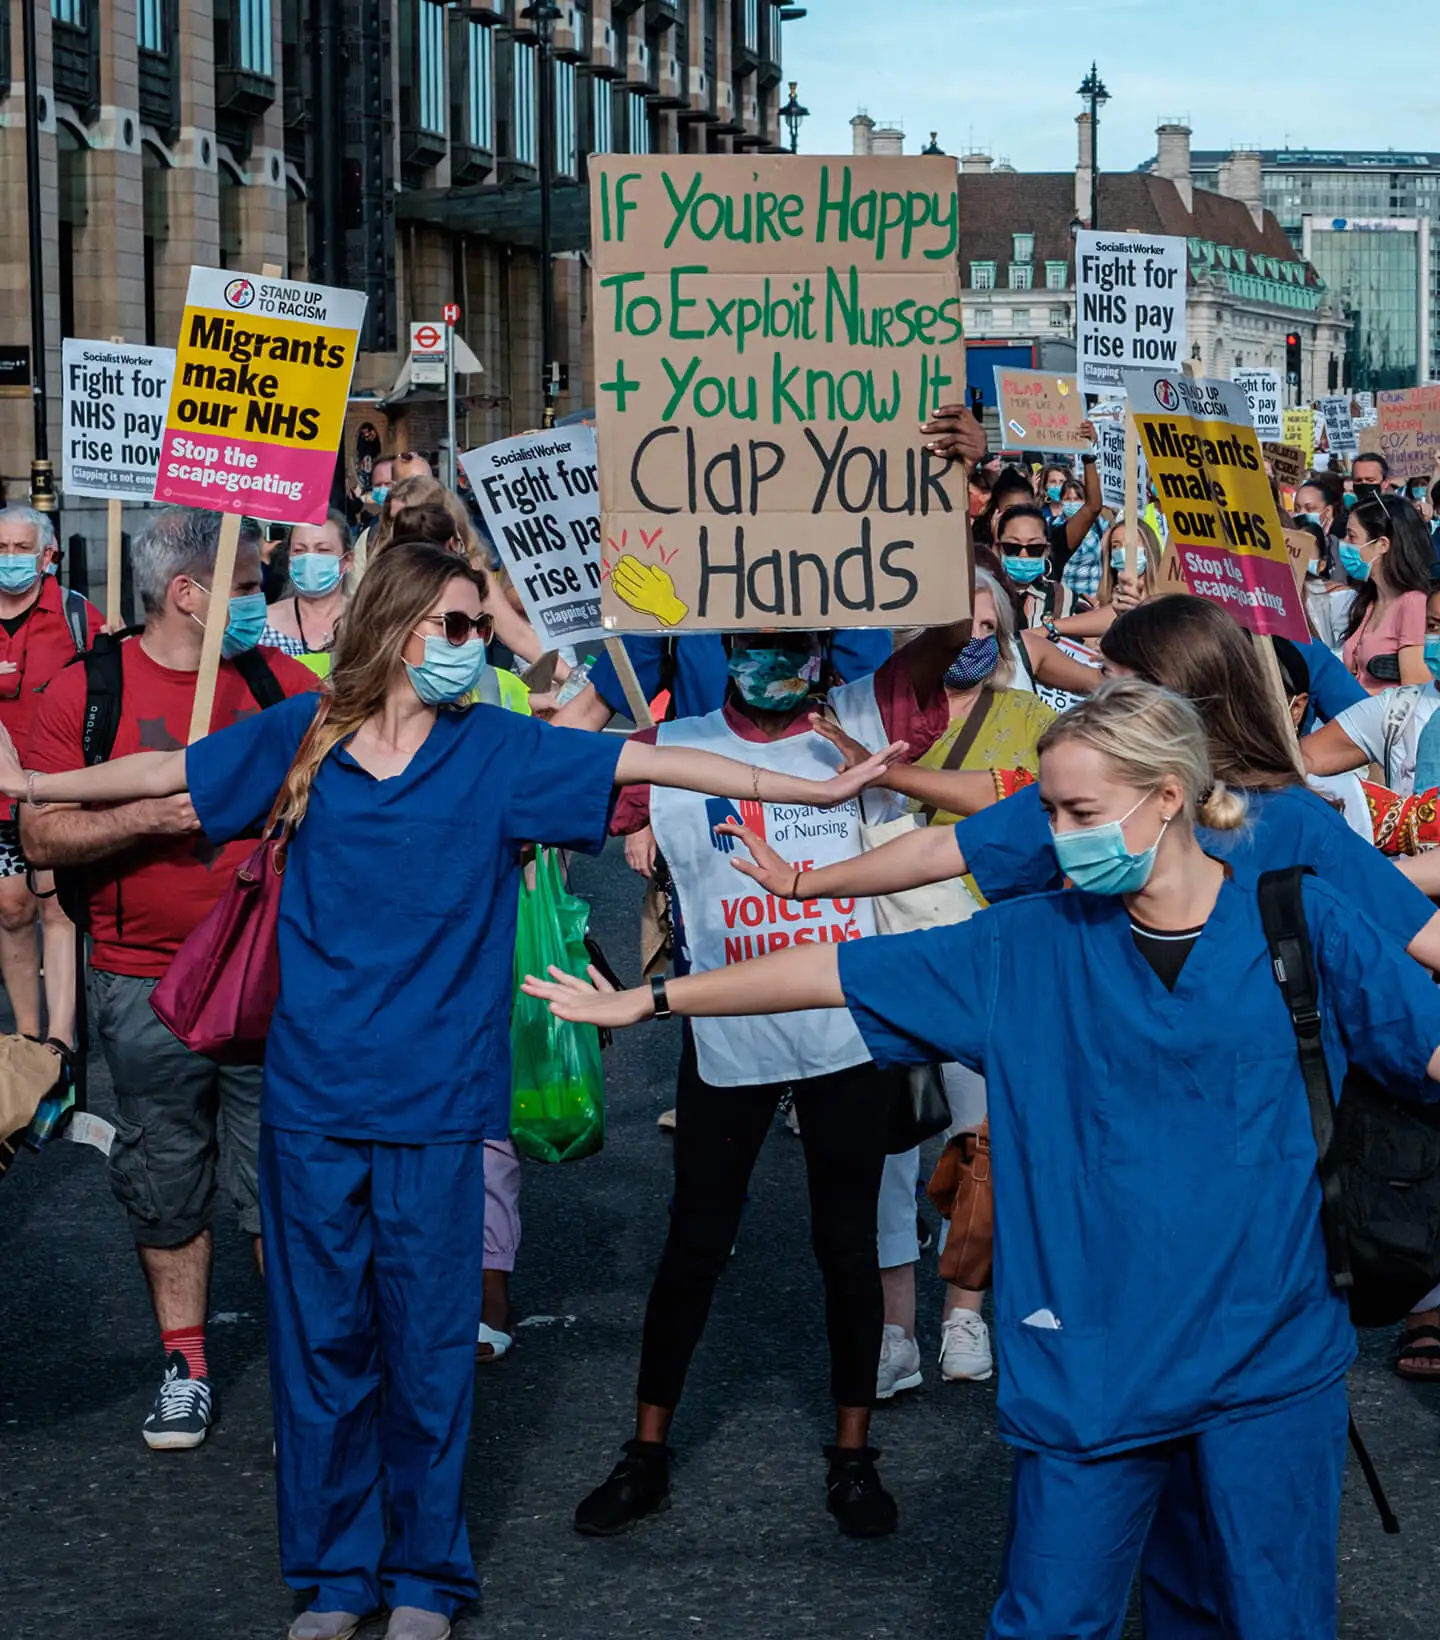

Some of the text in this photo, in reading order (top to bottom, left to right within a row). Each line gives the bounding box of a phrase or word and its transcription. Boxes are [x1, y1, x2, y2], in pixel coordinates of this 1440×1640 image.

[815, 165, 958, 260] Happy
[1082, 255, 1178, 292] Fight for
[258, 297, 328, 321] TO RACISM
[259, 284, 324, 304] STAND UP
[669, 265, 818, 353] Exploit
[1084, 293, 1174, 334] NHS pay
[188, 315, 346, 369] Migrants
[1084, 328, 1177, 361] rise now
[69, 364, 167, 399] Fight for
[182, 361, 279, 399] make
[1084, 363, 1120, 379] Clapping
[1261, 378, 1277, 392] for
[661, 356, 759, 422] You
[1206, 386, 1219, 400] UP
[1258, 399, 1277, 412] pay
[70, 400, 163, 440] NHS pay
[177, 399, 321, 441] our NHS
[1257, 414, 1278, 425] now
[71, 433, 113, 462] rise
[170, 437, 258, 469] Stop the
[1103, 452, 1122, 471] NHS
[167, 463, 304, 501] scapegoating
[481, 459, 599, 515] Fight for
[502, 513, 601, 561] NHS pa
[1173, 510, 1217, 538] our
[524, 563, 581, 602] rise
[699, 517, 919, 619] Hands
[1185, 552, 1225, 579] Stop
[774, 820, 849, 841] of Nursing
[721, 894, 822, 929] VOICE
